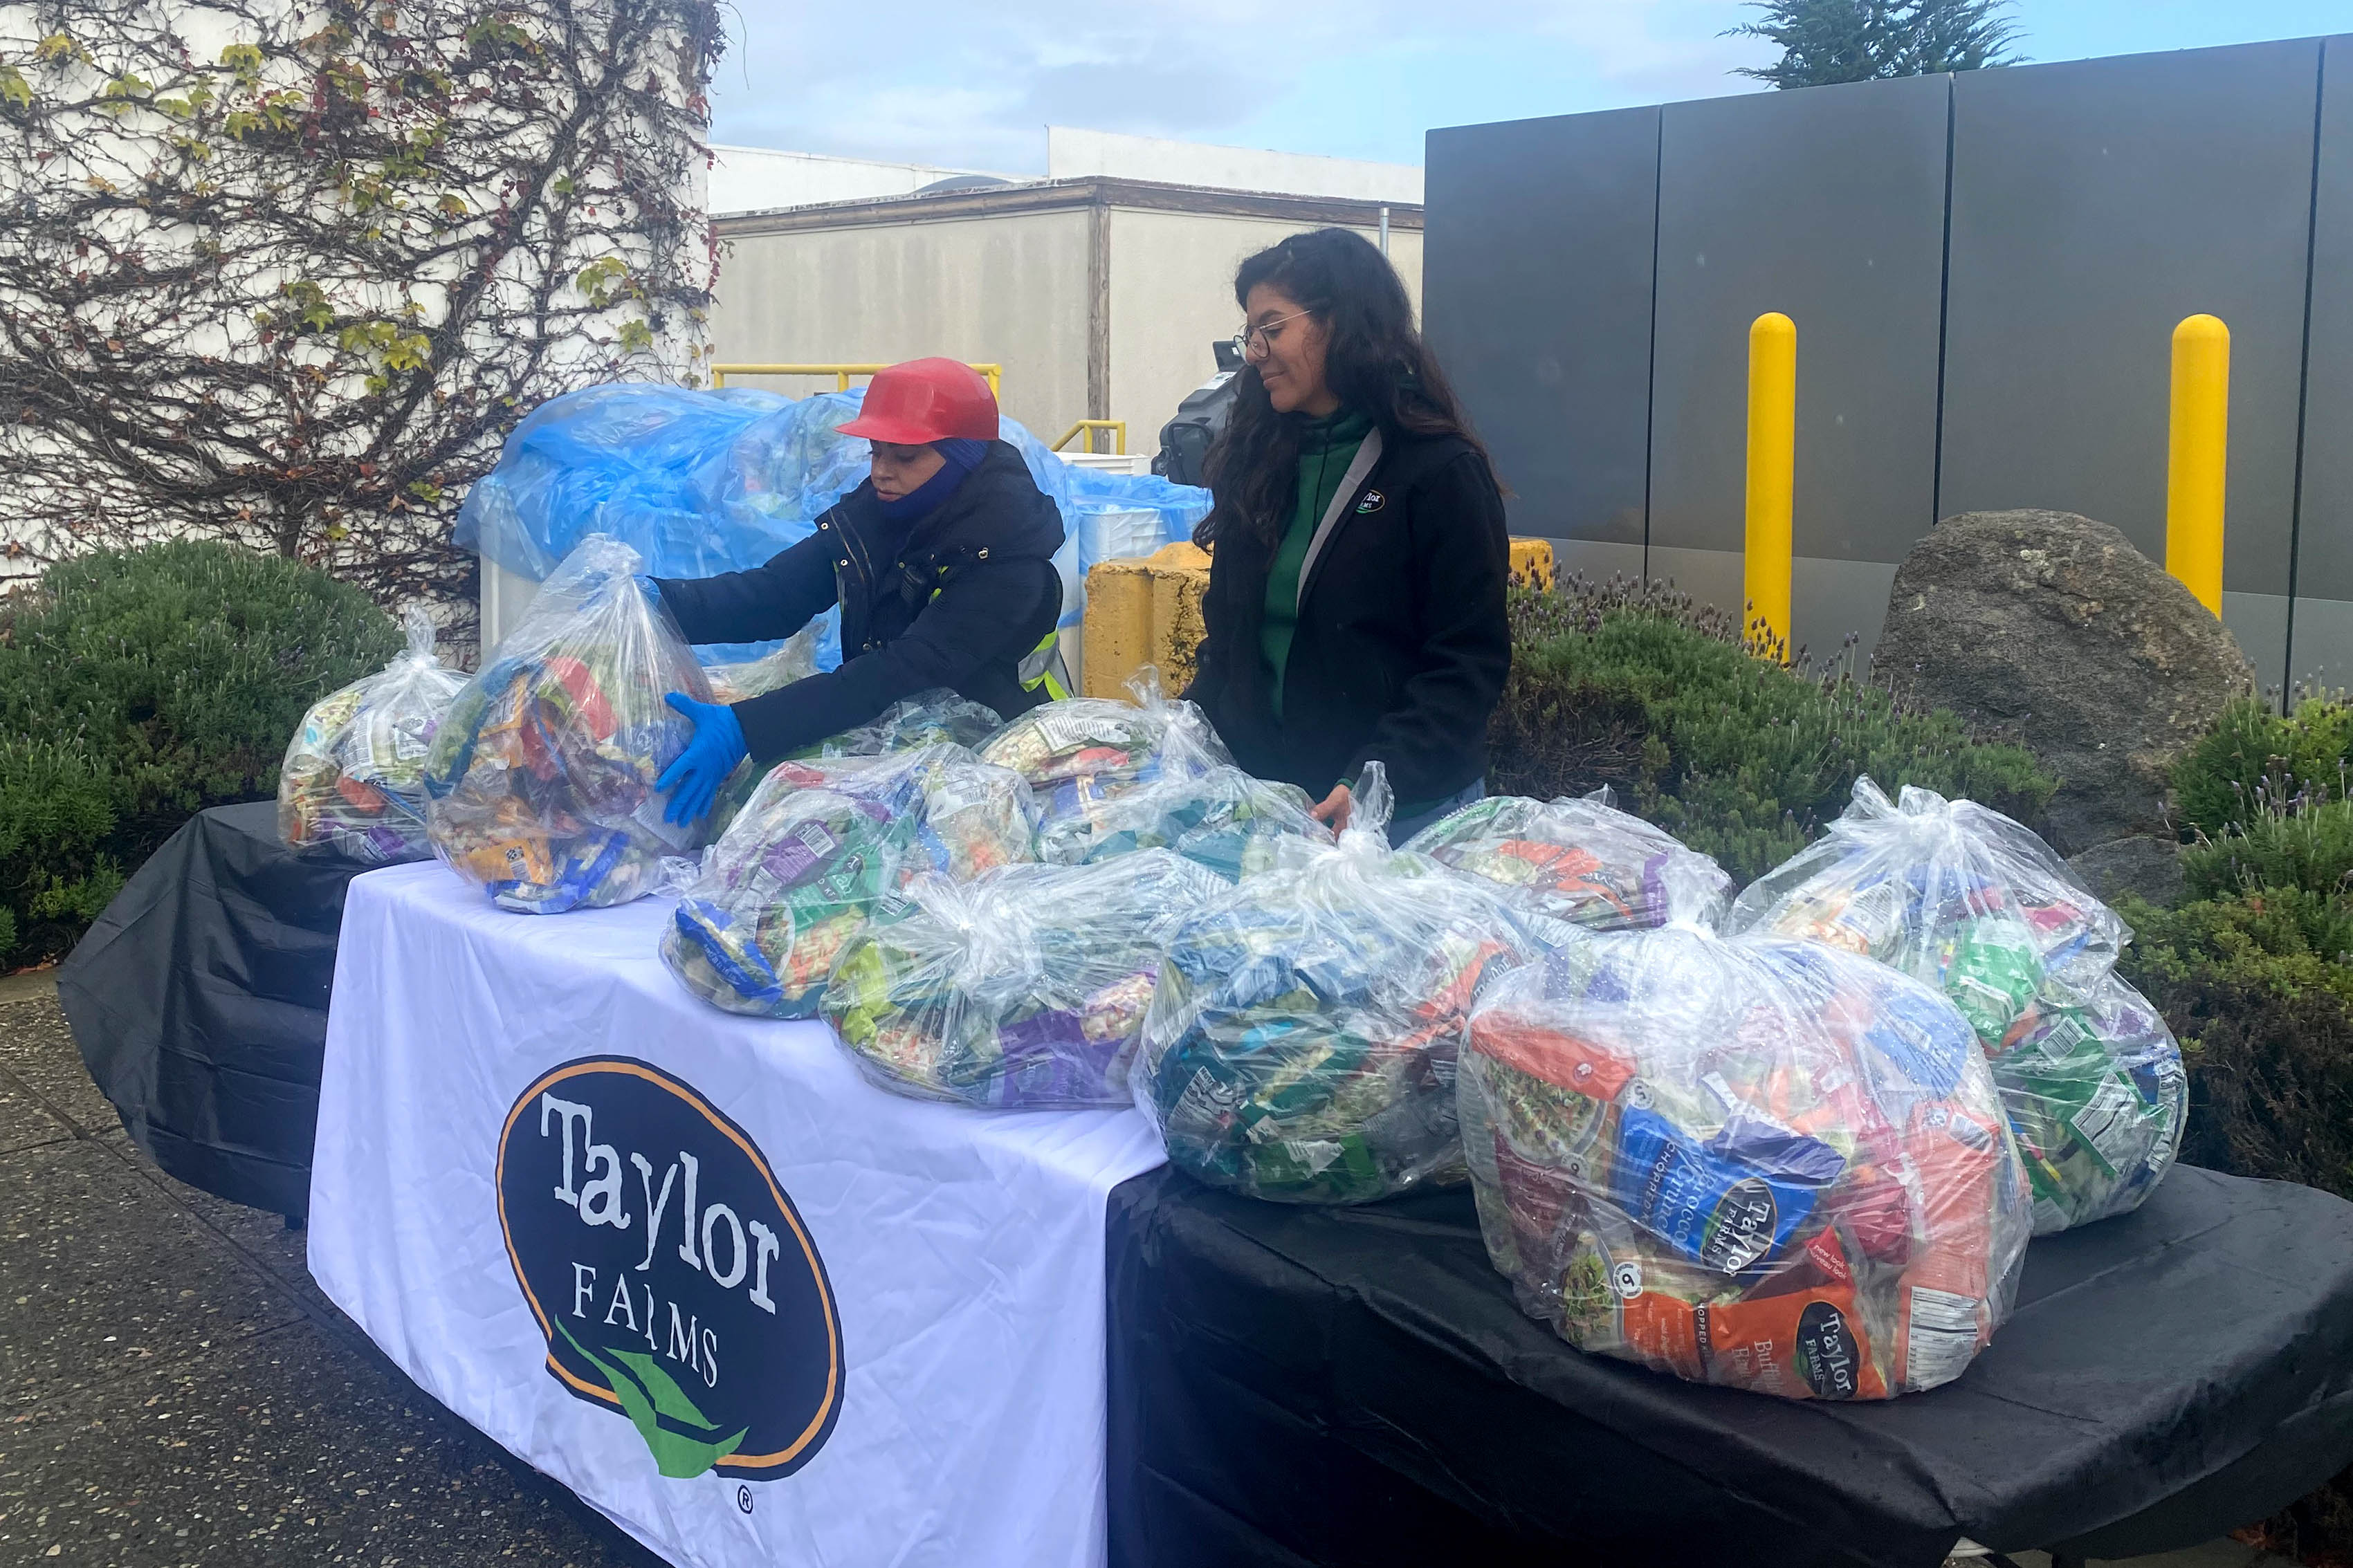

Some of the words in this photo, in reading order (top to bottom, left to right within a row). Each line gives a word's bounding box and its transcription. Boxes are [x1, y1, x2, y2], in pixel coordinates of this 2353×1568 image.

[540, 1091, 780, 1315] Taylor
[1656, 1165, 1693, 1230] Crunc
[1673, 1174, 1719, 1244] Brocco
[1712, 1208, 1738, 1255] FARMS
[1809, 1248, 1833, 1269] uveau
[1833, 1265, 1847, 1280] look
[1814, 1245, 1831, 1257] new
[1830, 1255, 1845, 1269] look
[1698, 1302, 1707, 1343] HOPPED
[1805, 1338, 1825, 1381] FARMS
[1820, 1313, 1853, 1392] Taylor
